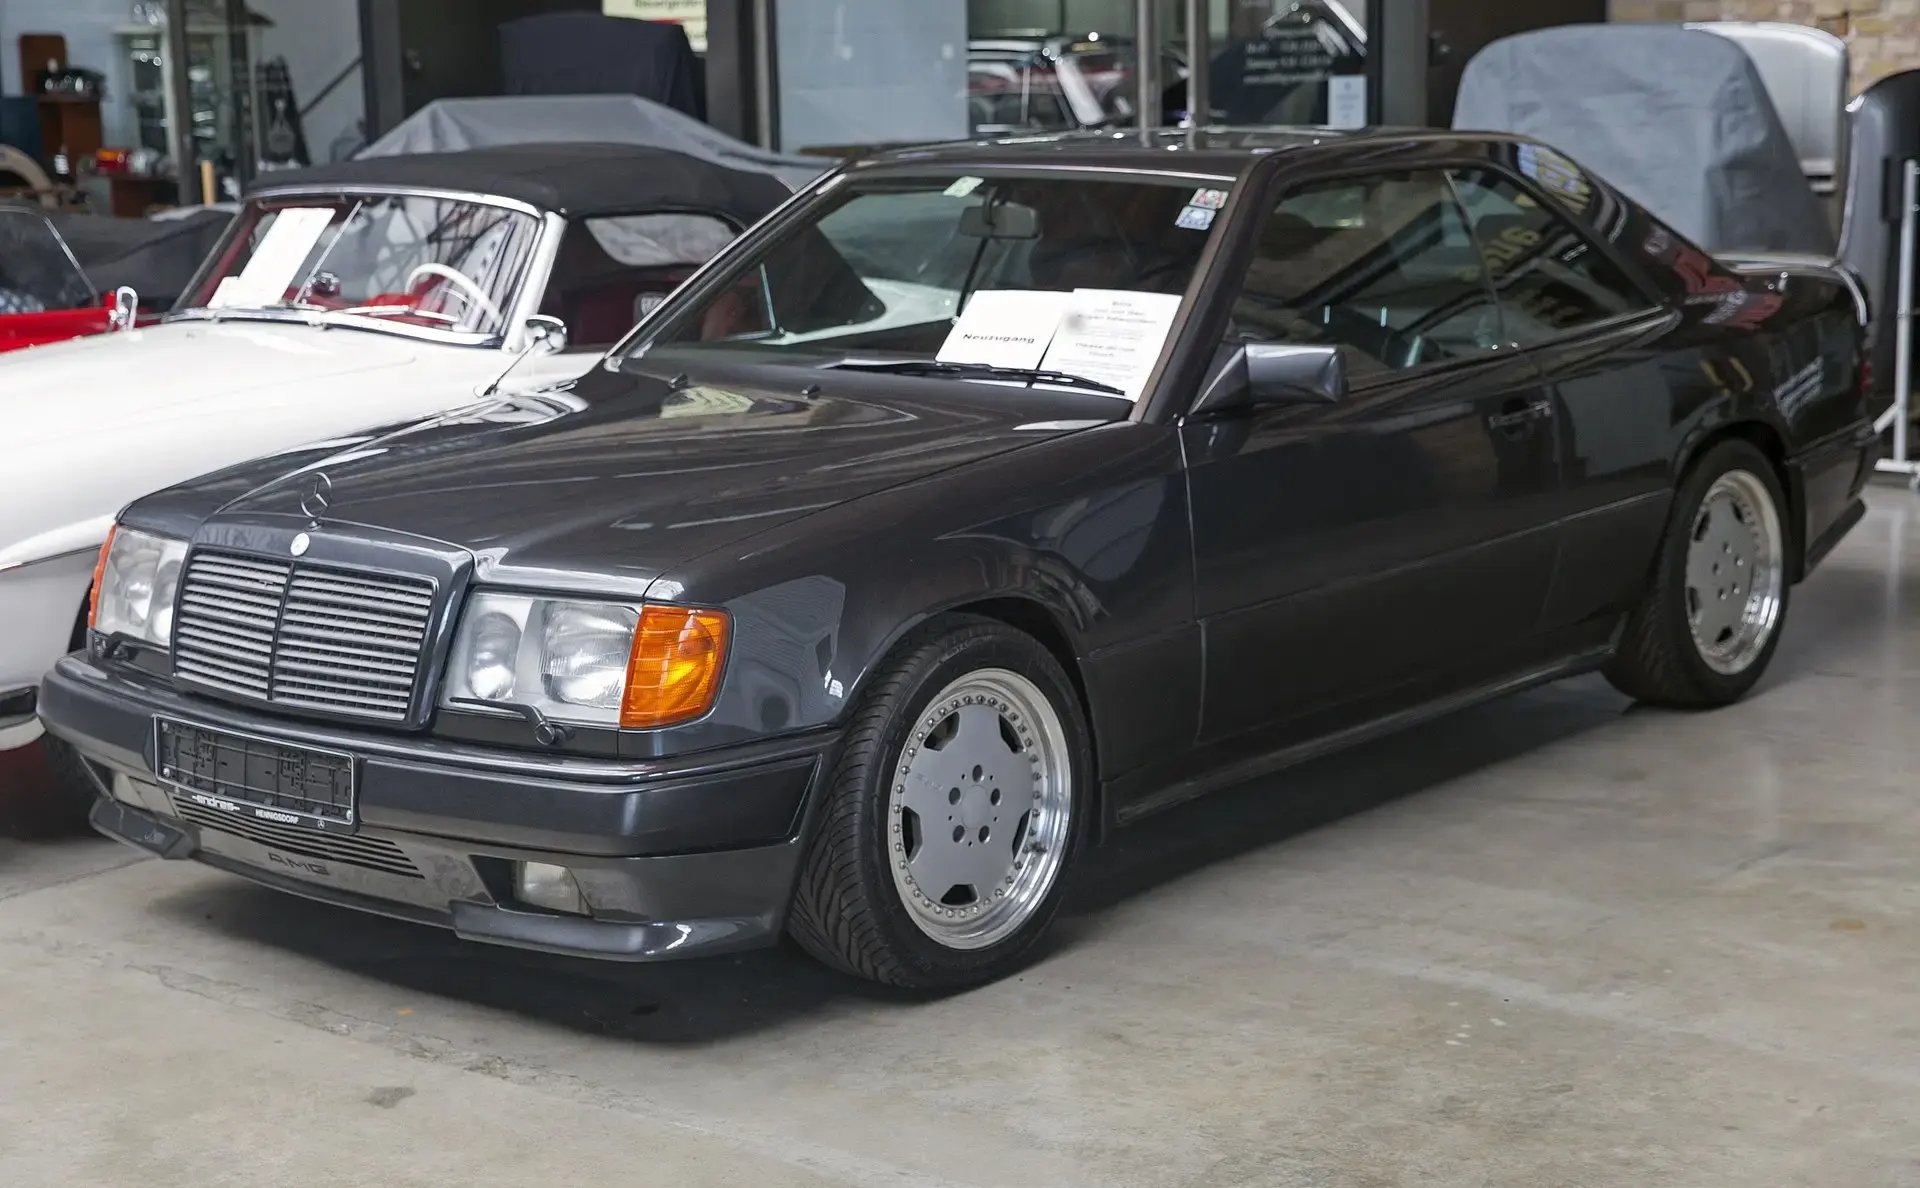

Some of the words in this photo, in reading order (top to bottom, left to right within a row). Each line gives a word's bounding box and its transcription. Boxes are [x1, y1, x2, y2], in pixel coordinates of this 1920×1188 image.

[962, 333, 1035, 344] Neuzugang
[255, 809, 299, 824] HENNIGSDORF
[268, 852, 331, 877] AMG
